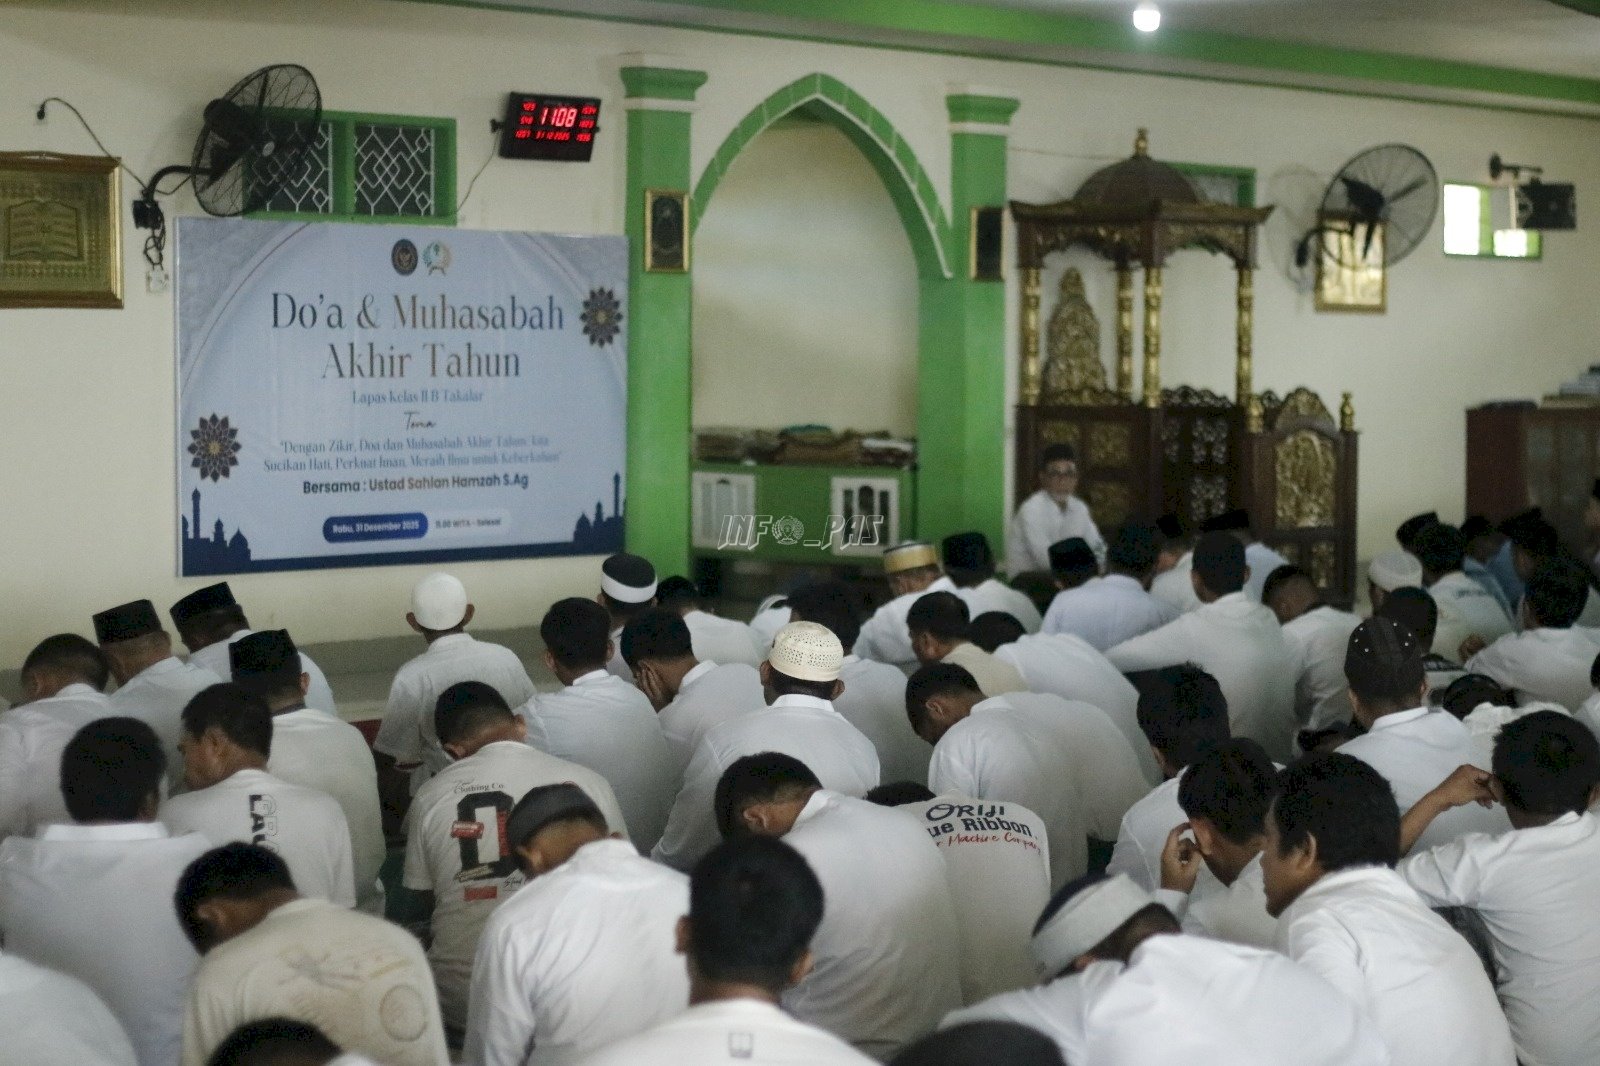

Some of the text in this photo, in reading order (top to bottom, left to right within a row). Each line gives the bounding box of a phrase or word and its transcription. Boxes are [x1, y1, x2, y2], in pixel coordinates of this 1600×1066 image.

[357, 293, 380, 330] &
[393, 294, 564, 330] Muhasabah
[321, 342, 520, 379] Akhir Tahun
[352, 389, 387, 406] Lapas
[389, 389, 418, 403] Kelas
[444, 388, 483, 402] Takalar
[404, 411, 437, 431] Tema
[359, 438, 381, 452] Doa
[383, 437, 403, 451] dan
[406, 436, 463, 450] Muhasabah
[467, 435, 492, 448] Akhir
[264, 459, 306, 472] Sucikan
[335, 456, 376, 470] Perkuat
[410, 453, 445, 467] Meraih
[303, 480, 361, 494] Bersama
[369, 478, 405, 491] Ustad
[408, 475, 449, 490] Sahlan
[452, 473, 500, 488] Hamzah
[503, 471, 529, 490] S.Ag
[364, 521, 401, 532] Desember
[926, 803, 1005, 821] ORIJI
[927, 817, 1032, 837] ue Ribbon
